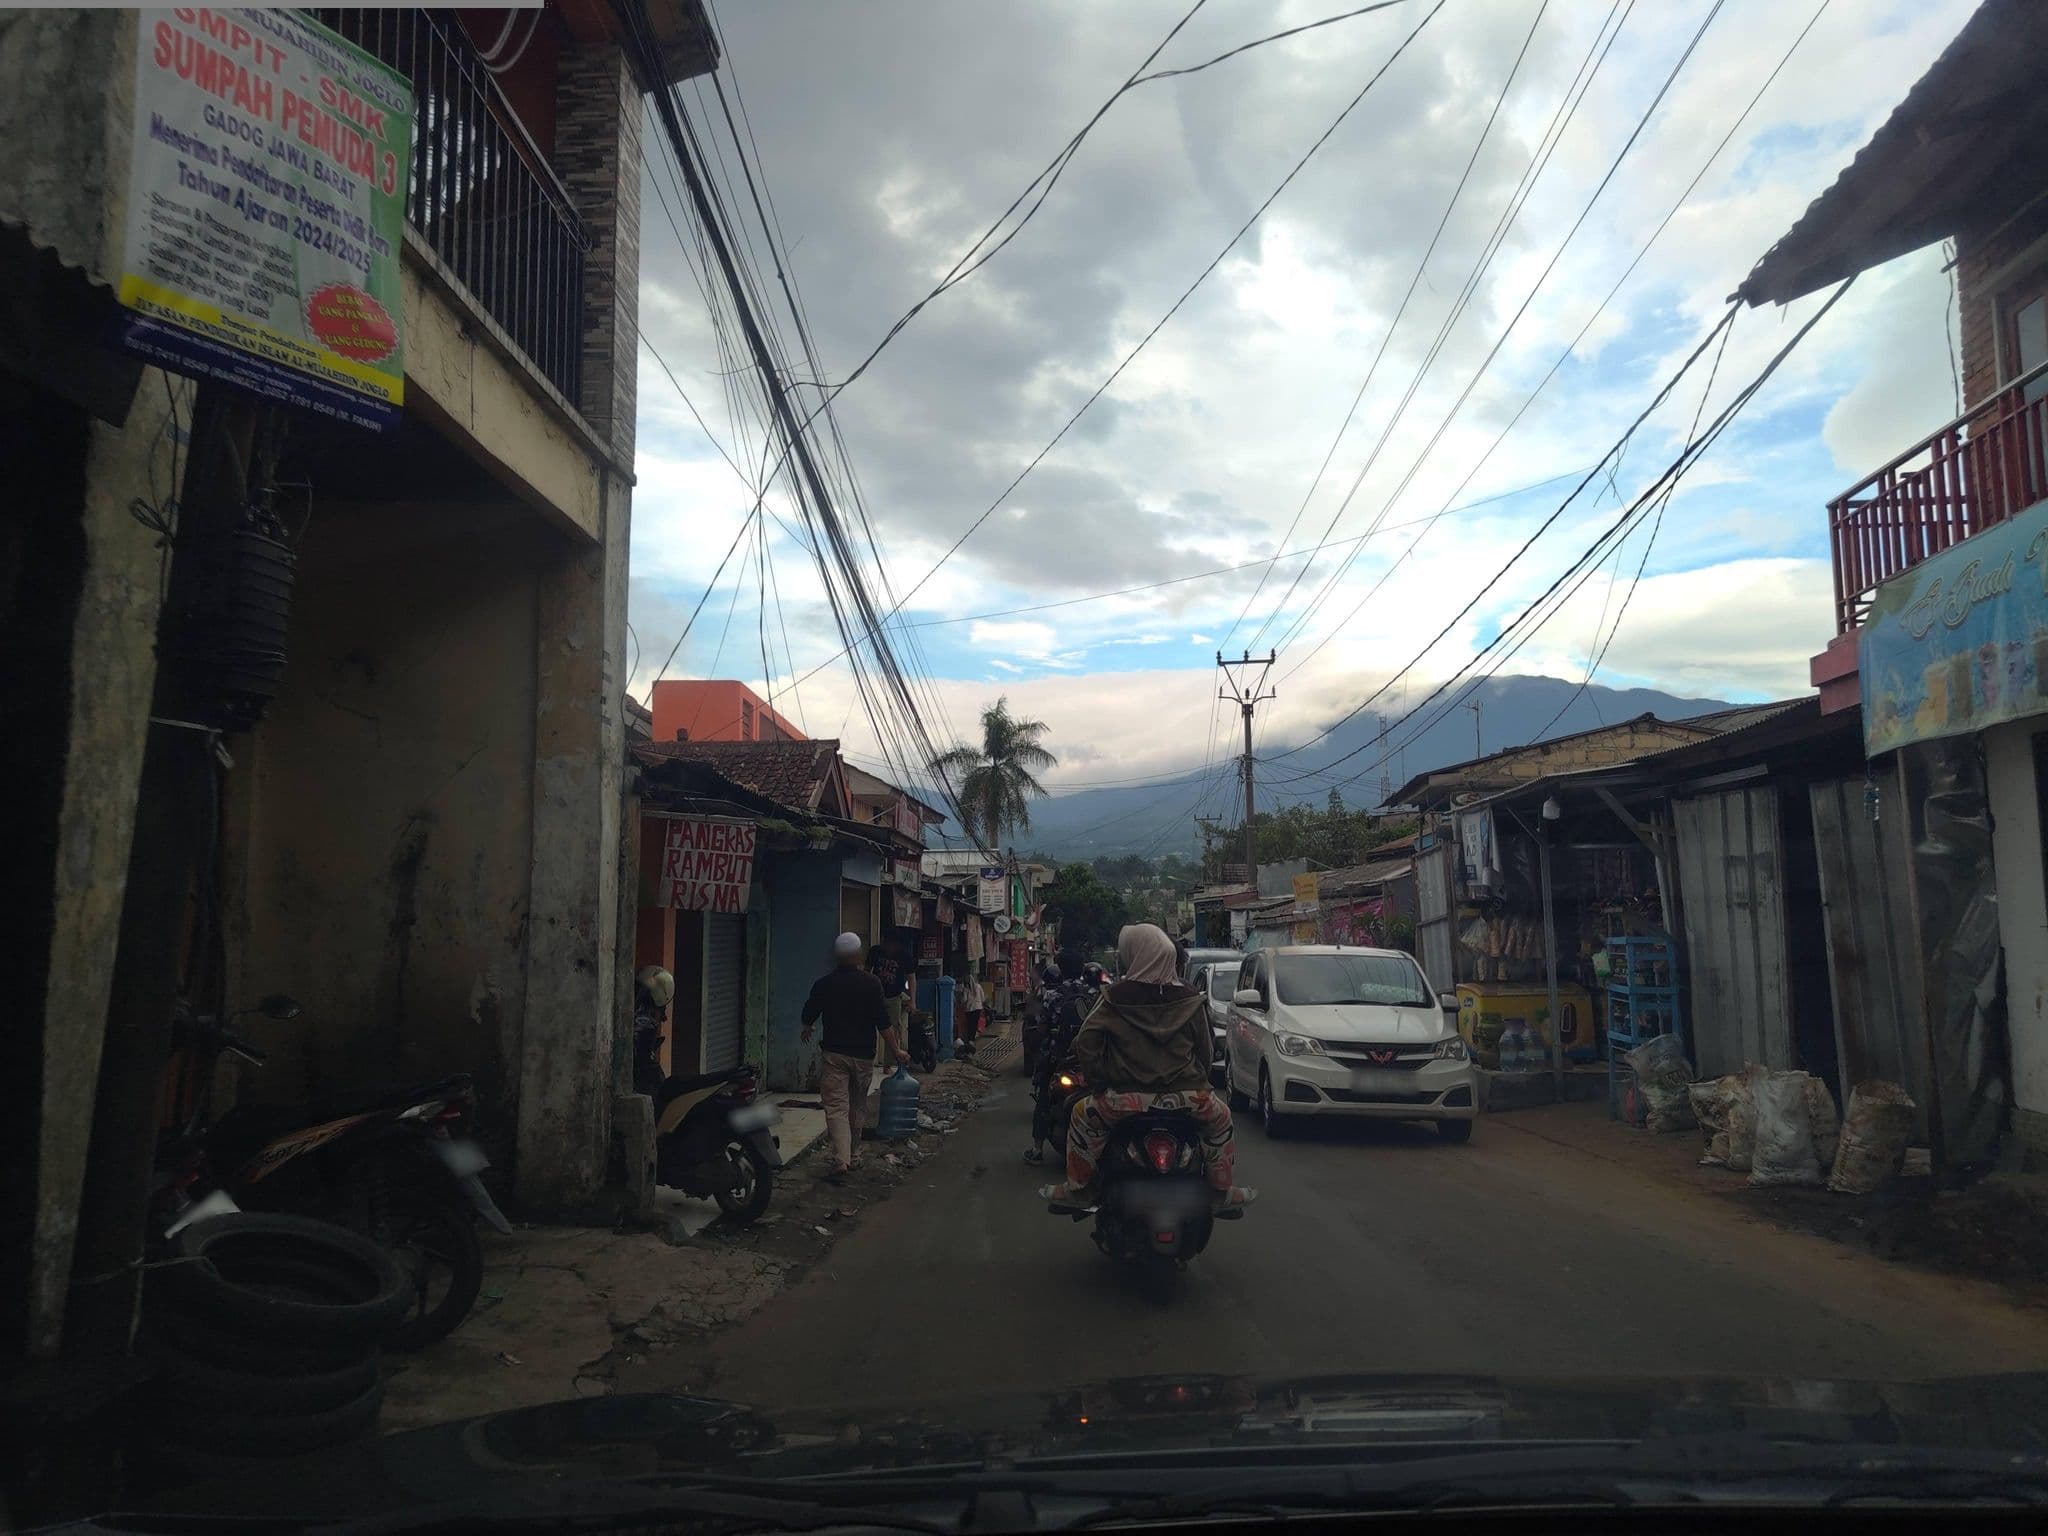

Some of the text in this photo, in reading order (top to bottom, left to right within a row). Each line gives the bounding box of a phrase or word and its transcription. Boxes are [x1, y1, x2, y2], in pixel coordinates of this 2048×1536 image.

[154, 20, 397, 195] SUMPAH PEMUDA 3
[319, 77, 386, 142] SMK
[204, 104, 356, 200] GADOG JAWA BARAT
[178, 159, 371, 273] Tahun Ajaran 2024/2025
[666, 849, 753, 884] RAMBUT
[667, 818, 756, 853] PANGKAS
[671, 880, 741, 912] RISNA
